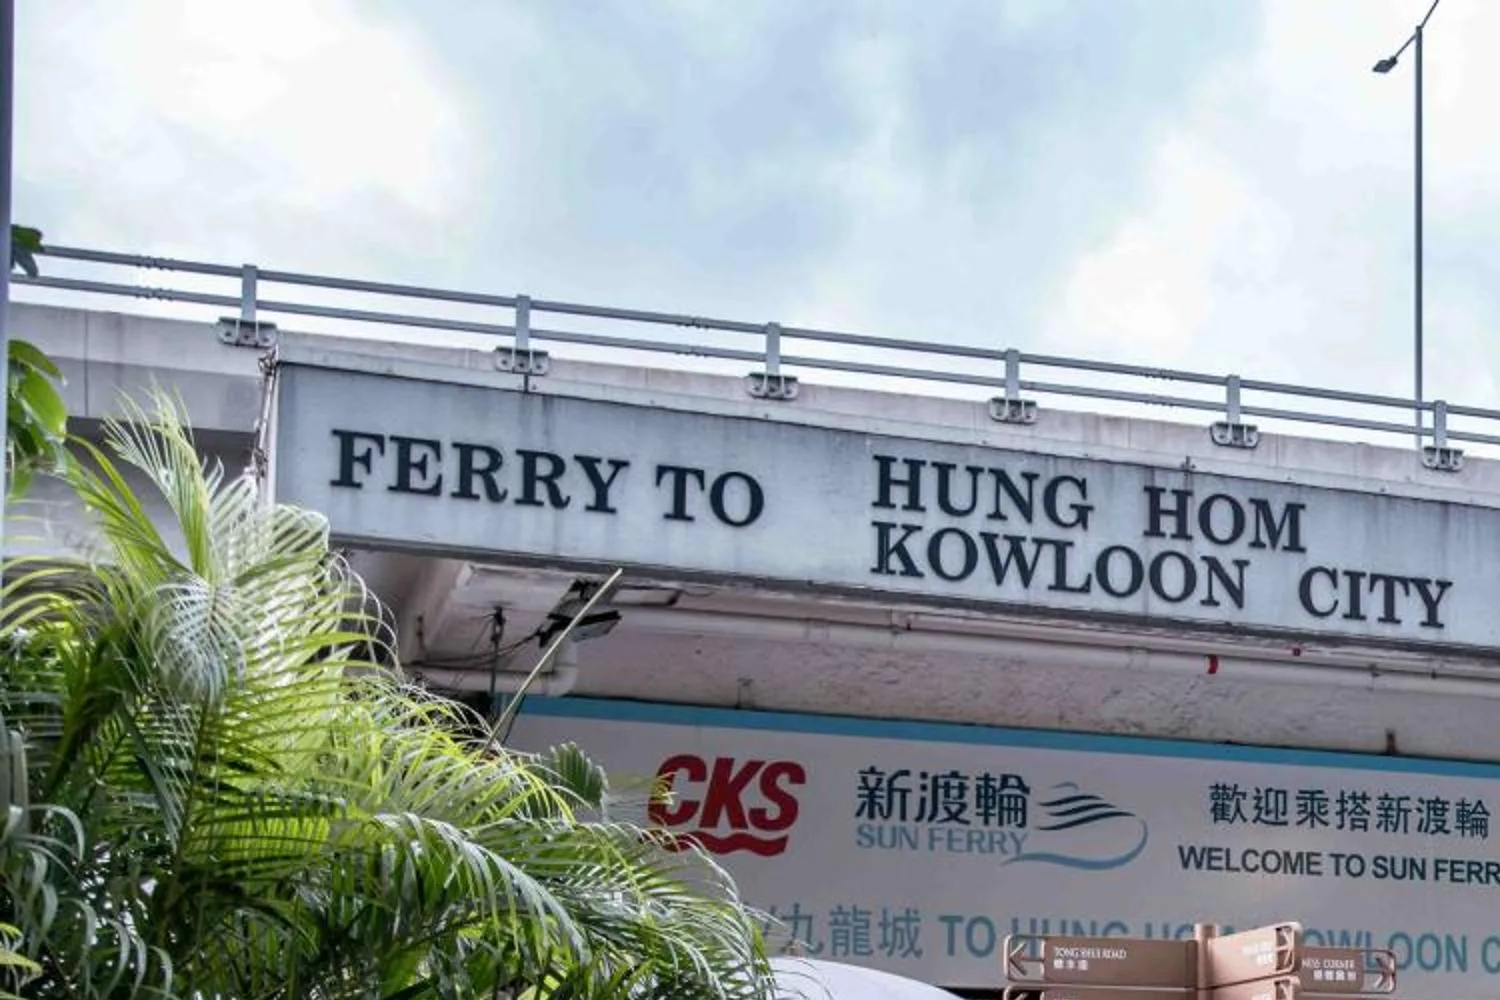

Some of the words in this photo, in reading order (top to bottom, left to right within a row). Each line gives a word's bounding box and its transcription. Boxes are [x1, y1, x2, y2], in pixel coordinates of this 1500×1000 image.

[330, 429, 630, 514] FERRY
[655, 464, 766, 527] TO
[871, 454, 1094, 532] HUNG
[1142, 485, 1308, 553] HOM
[869, 520, 1251, 609] KOWLOON
[1298, 566, 1453, 629] CITY
[648, 754, 807, 831] CKS
[855, 765, 1031, 828] 新渡輪
[1209, 783, 1491, 840] 歡迎乘搭新渡輪
[856, 823, 919, 851] SUN
[928, 827, 1028, 856] FERRY
[1178, 845, 1323, 877] WELCOME
[1329, 853, 1366, 878] TO
[1372, 855, 1426, 881] SUN
[939, 915, 997, 957] TO
